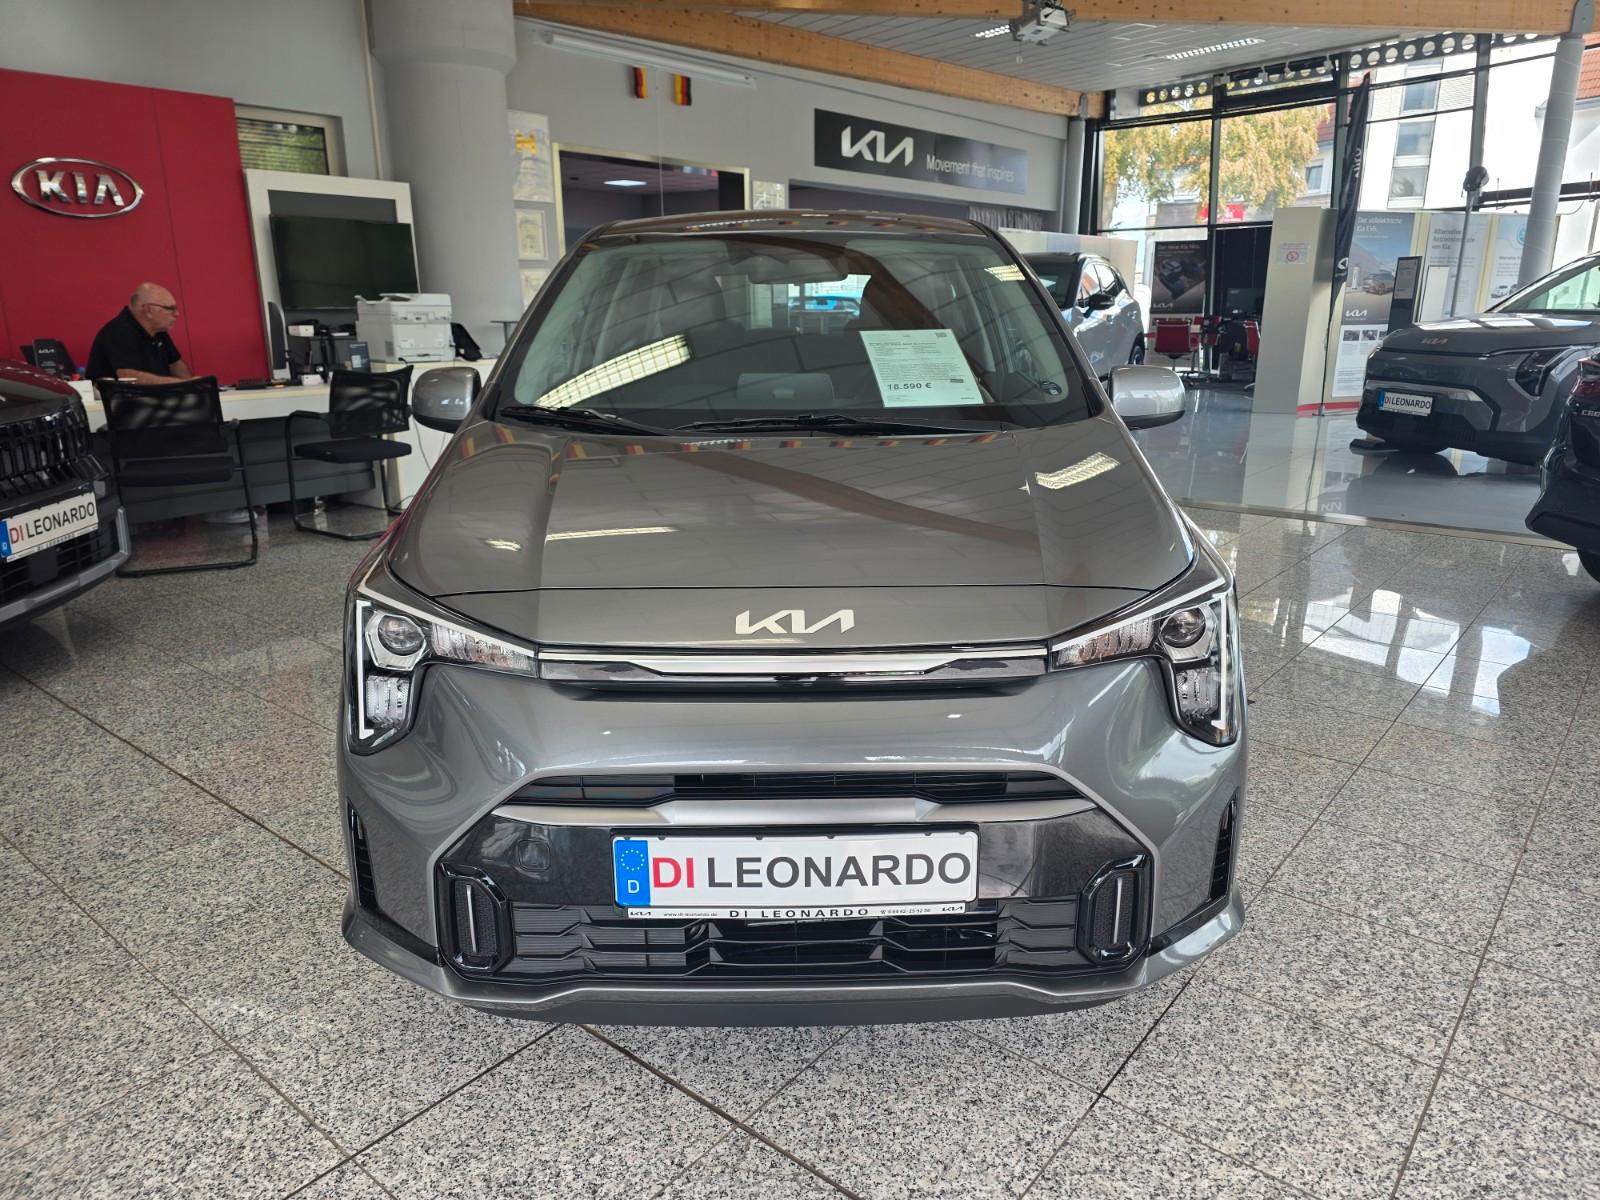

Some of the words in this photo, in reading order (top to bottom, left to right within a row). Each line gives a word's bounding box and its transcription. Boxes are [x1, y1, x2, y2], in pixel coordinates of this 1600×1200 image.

[841, 126, 914, 167] KIA
[926, 153, 970, 176] Movement
[972, 161, 986, 177] that
[987, 163, 1015, 183] inspires
[35, 169, 125, 207] KIA
[1391, 397, 1431, 410] LEONARDO
[8, 524, 25, 545] DI
[25, 502, 95, 539] LEONARDO
[735, 609, 855, 635] KIA
[652, 857, 695, 889] DI
[707, 852, 971, 889] LEONARDO
[627, 879, 640, 894] D
[729, 910, 748, 918] DI
[761, 908, 869, 918] LEONARDO
